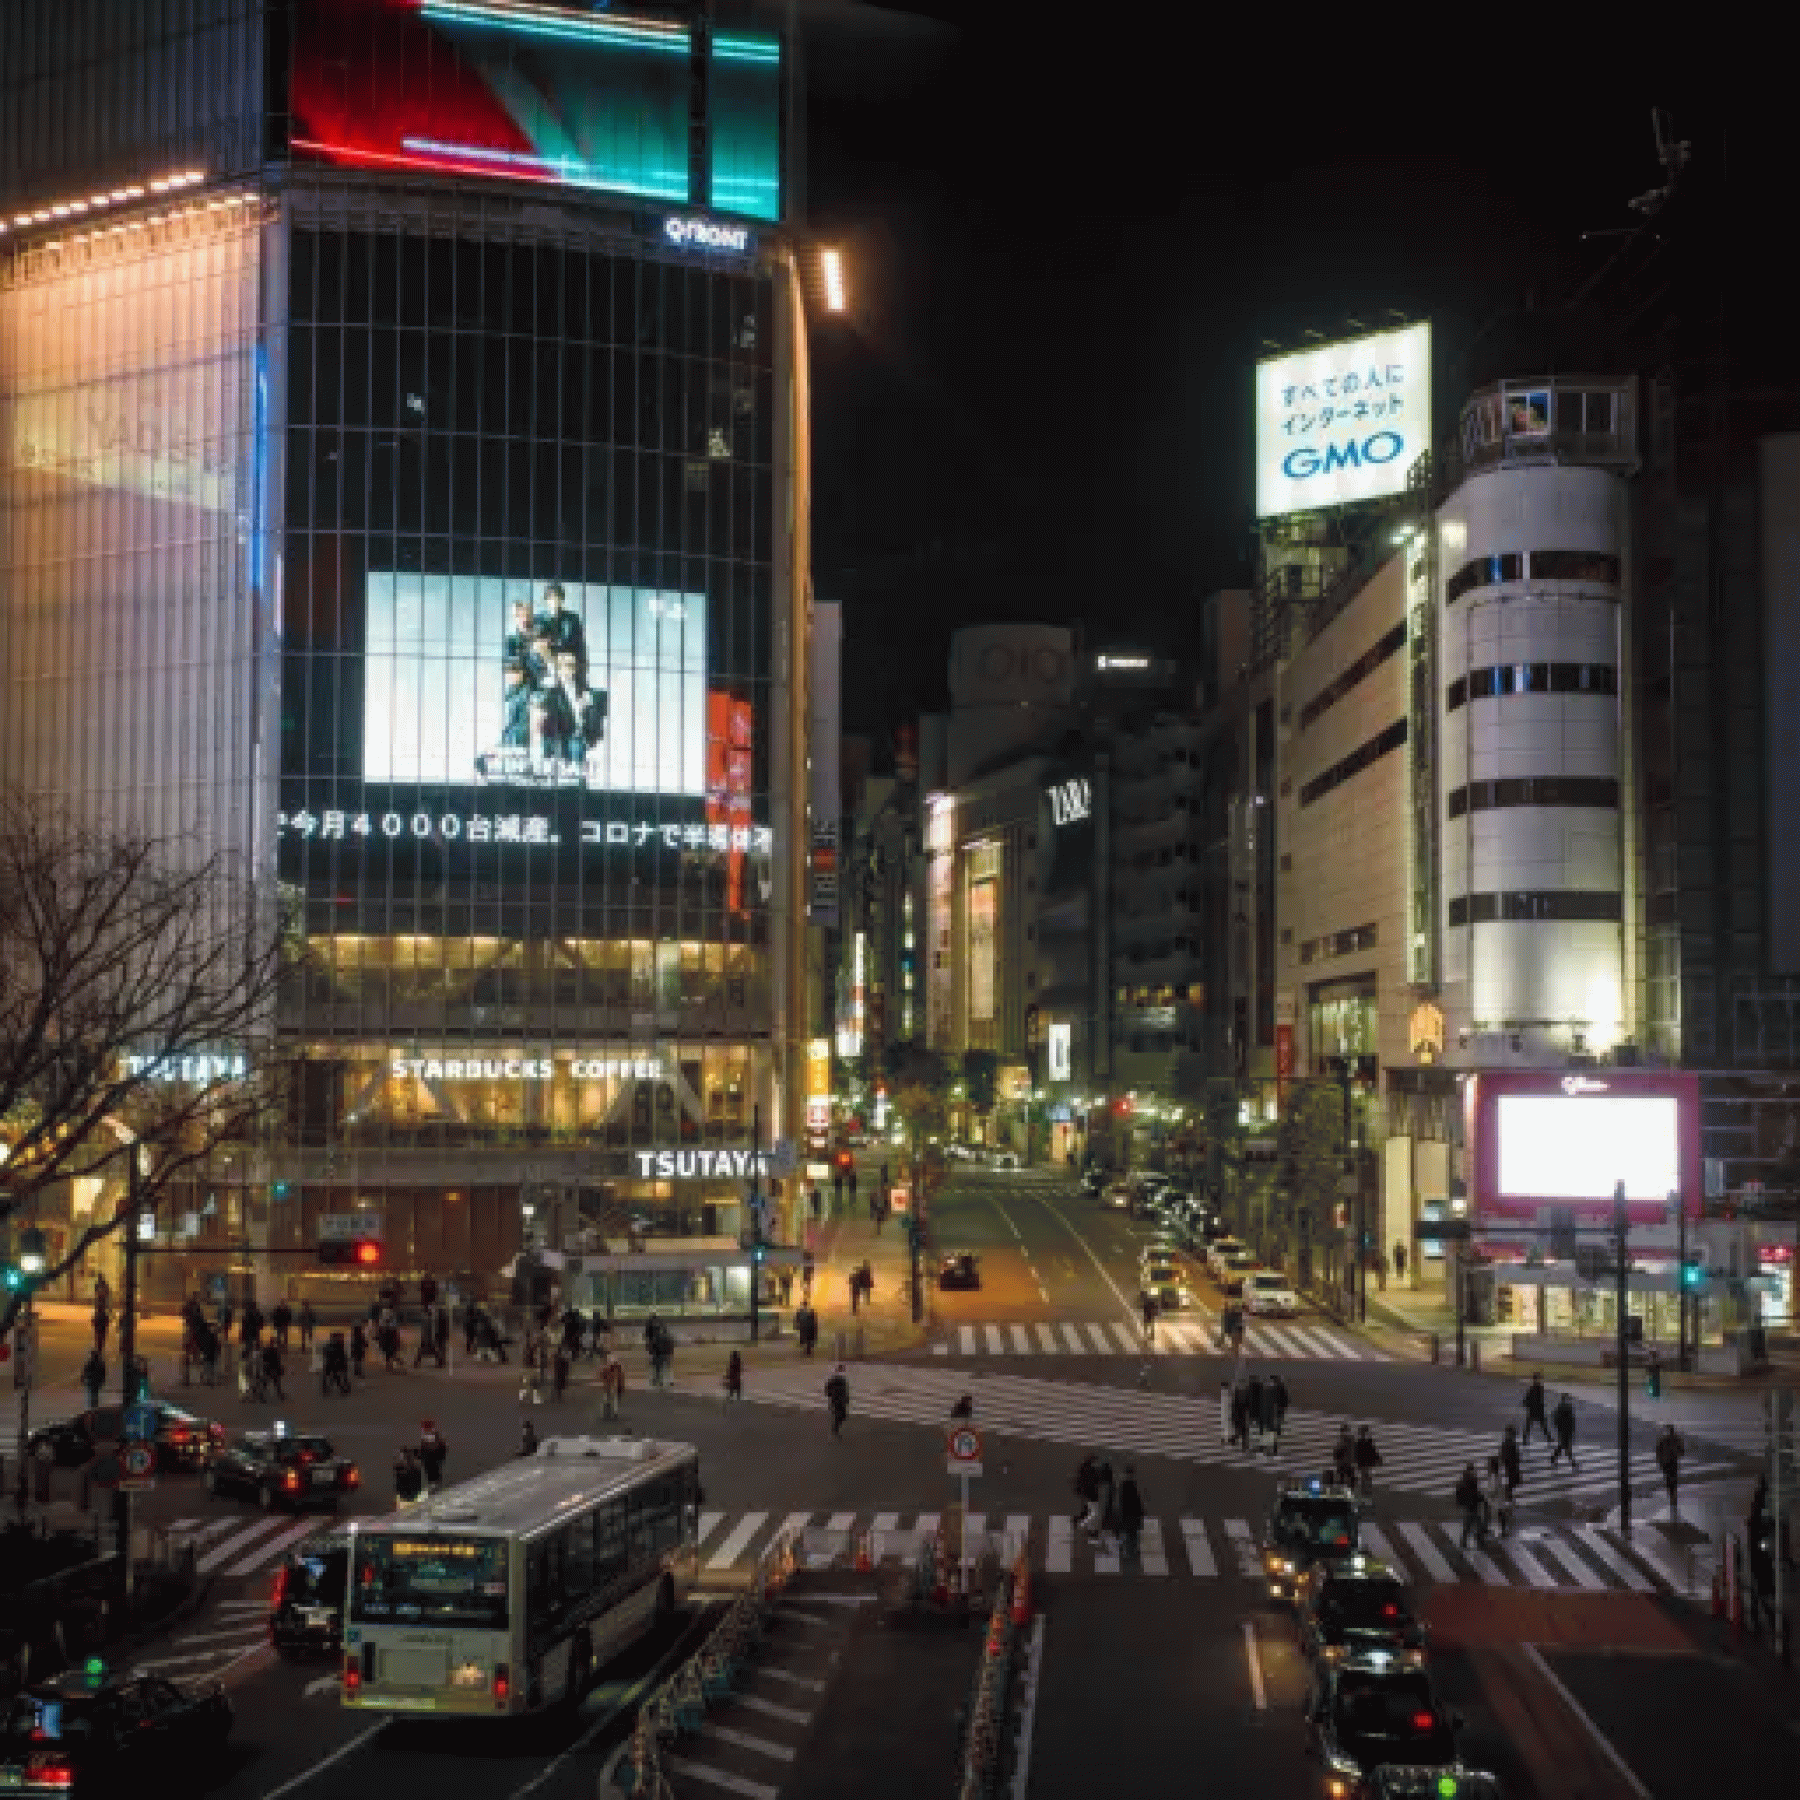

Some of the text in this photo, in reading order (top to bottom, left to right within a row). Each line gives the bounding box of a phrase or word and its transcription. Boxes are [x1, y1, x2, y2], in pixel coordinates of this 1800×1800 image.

[1281, 364, 1404, 407] すべての人に
[1281, 393, 1404, 435] インターネット
[1281, 431, 1404, 479] GMO
[391, 1058, 662, 1079] STARBUCKS COFFEE
[636, 1150, 768, 1177] TSUTAYA
